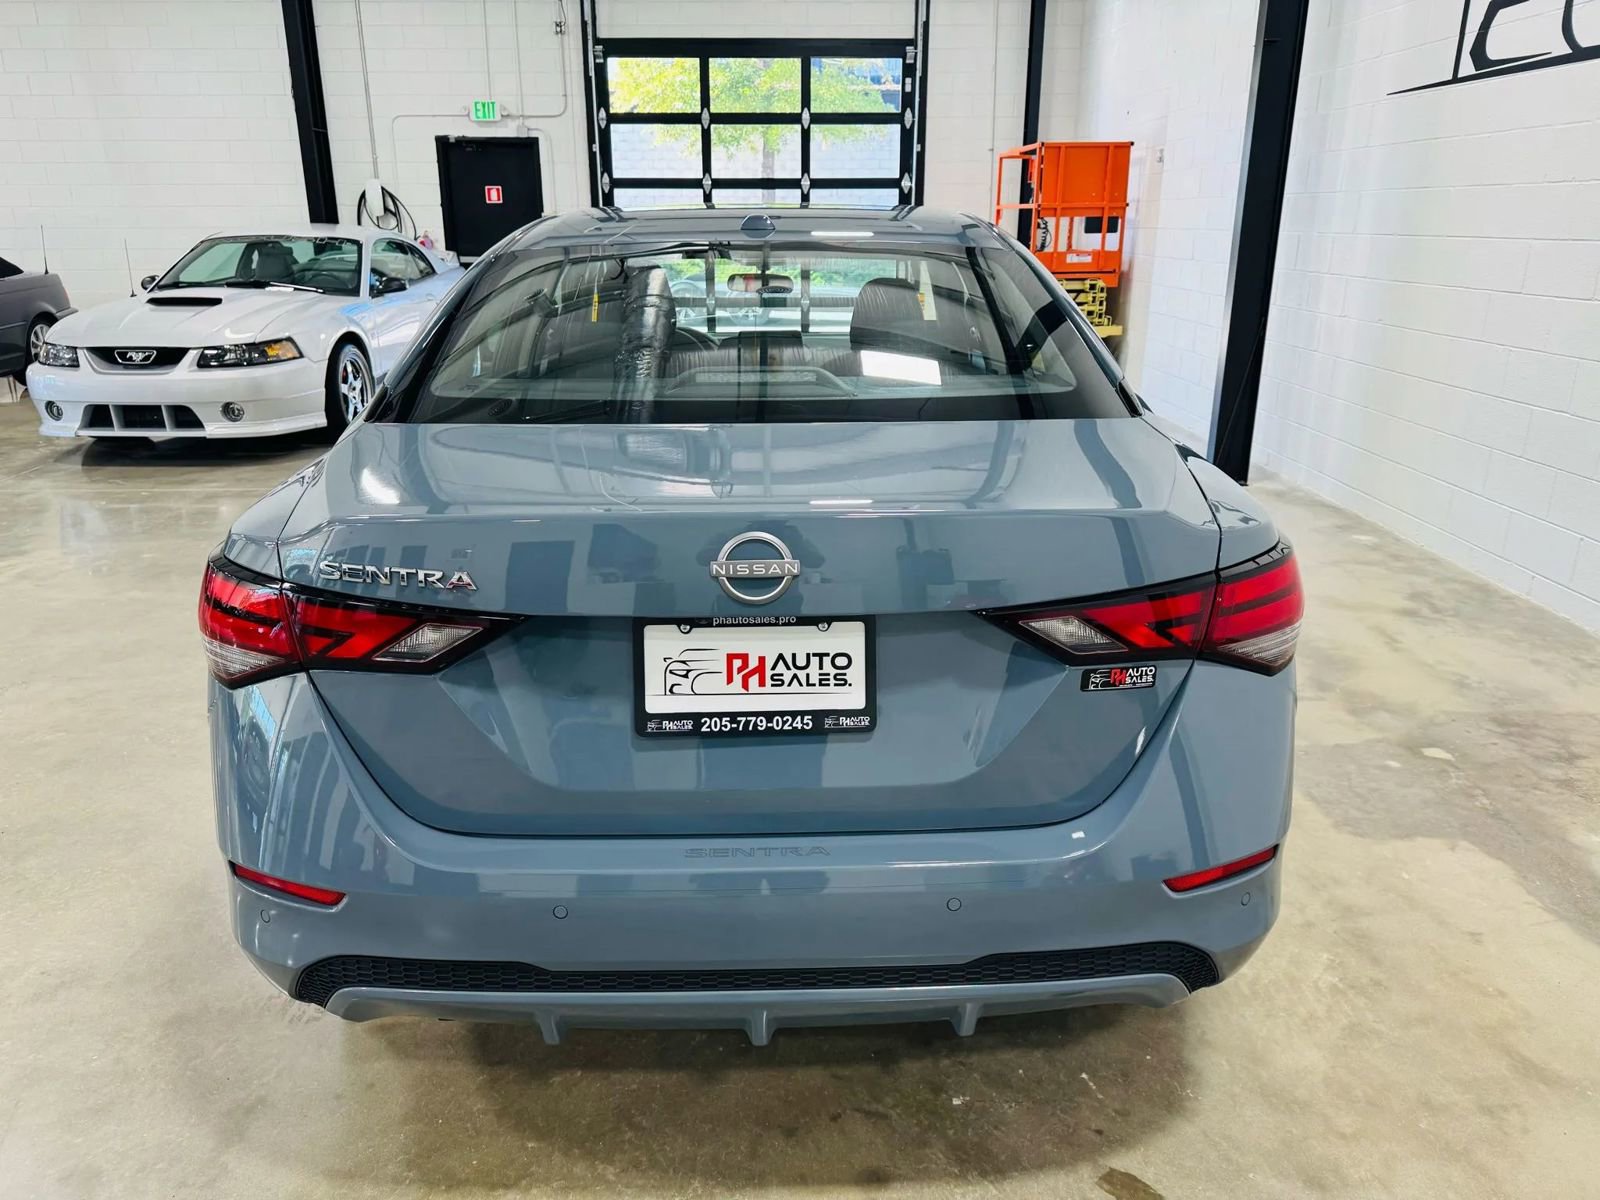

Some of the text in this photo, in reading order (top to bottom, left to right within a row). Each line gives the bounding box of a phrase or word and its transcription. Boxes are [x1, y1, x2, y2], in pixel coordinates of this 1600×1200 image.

[474, 101, 496, 119] EXIT
[319, 560, 478, 591] SENTRA
[712, 563, 798, 575] NISSAN
[712, 616, 797, 626] phautosales.pro
[726, 652, 853, 692] PH AUTO
[1126, 666, 1155, 676] AUTO
[770, 672, 853, 688] SALES.
[700, 716, 813, 732] 205-779-0245
[684, 846, 831, 858] SENTRA
